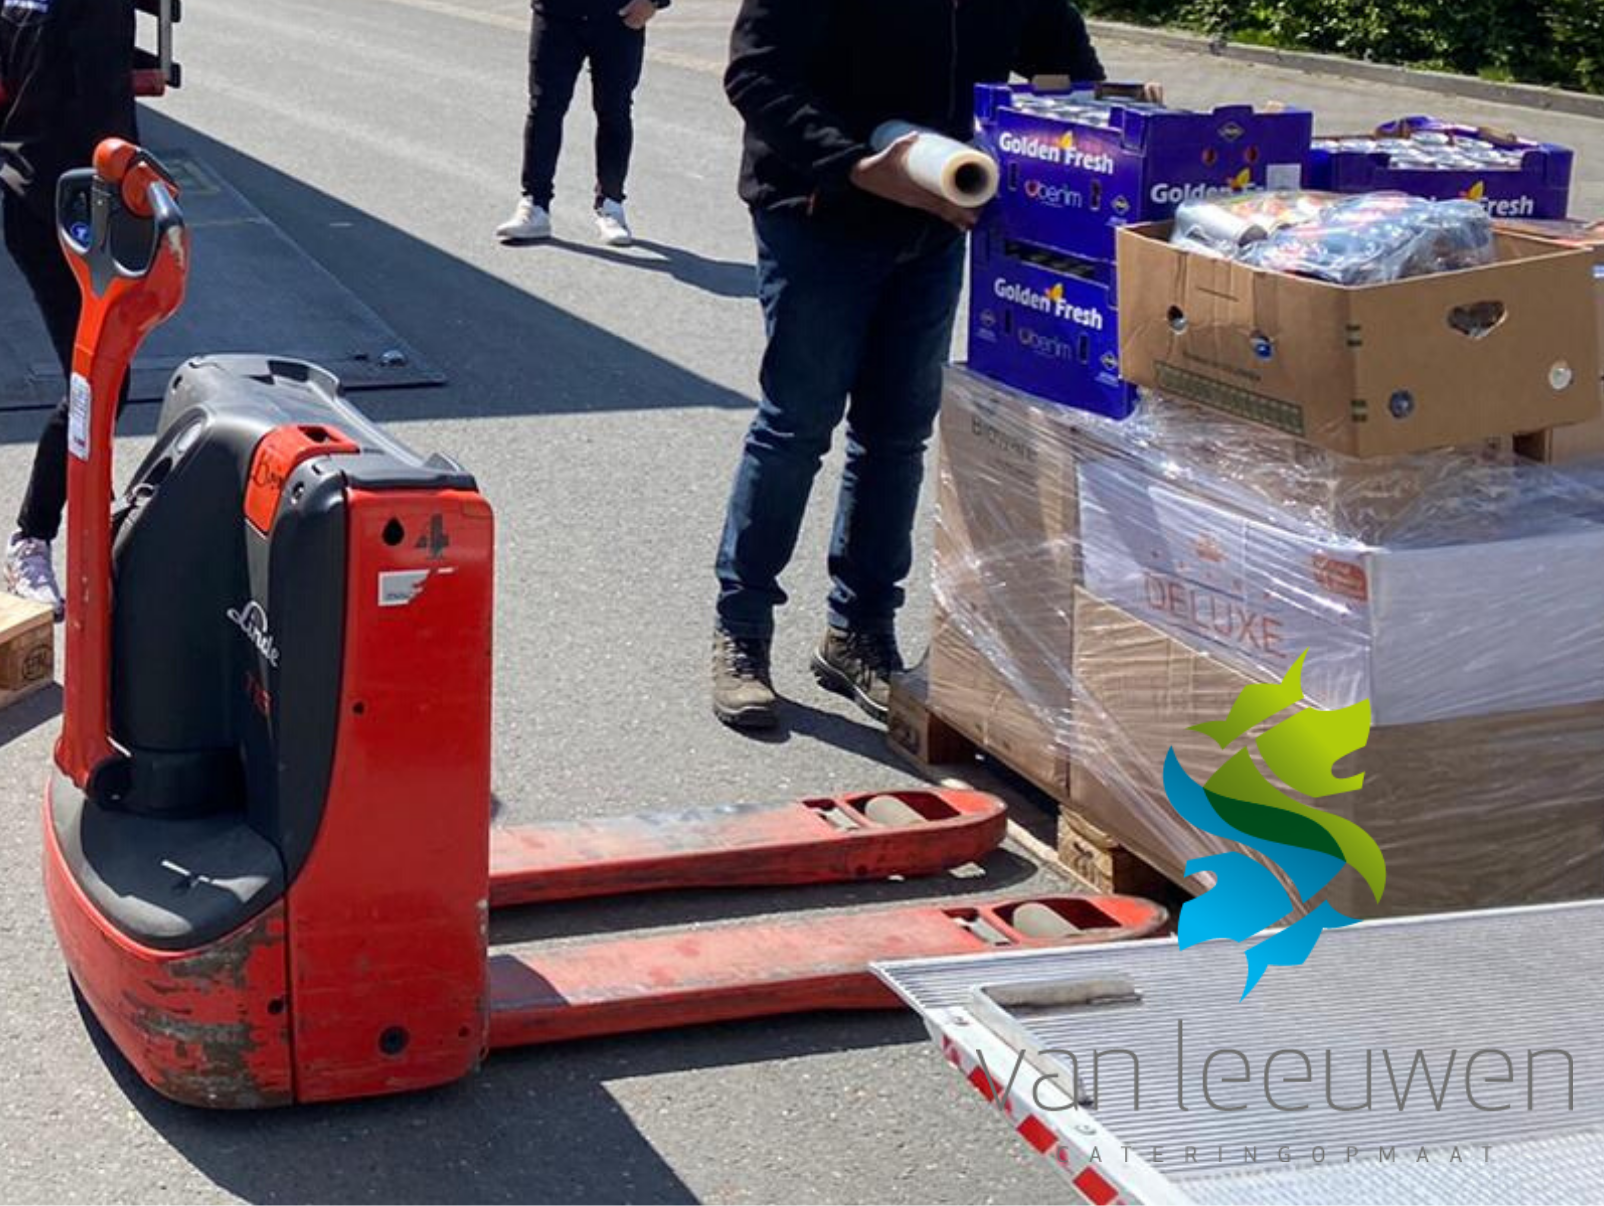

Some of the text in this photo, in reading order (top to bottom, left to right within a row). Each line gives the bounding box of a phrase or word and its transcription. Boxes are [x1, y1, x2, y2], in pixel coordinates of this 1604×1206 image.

[999, 131, 1114, 175] Golden Fresh
[994, 278, 1104, 330] Golden Fresh
[227, 600, 280, 667] Linde
[1145, 571, 1288, 660] DELUXE
